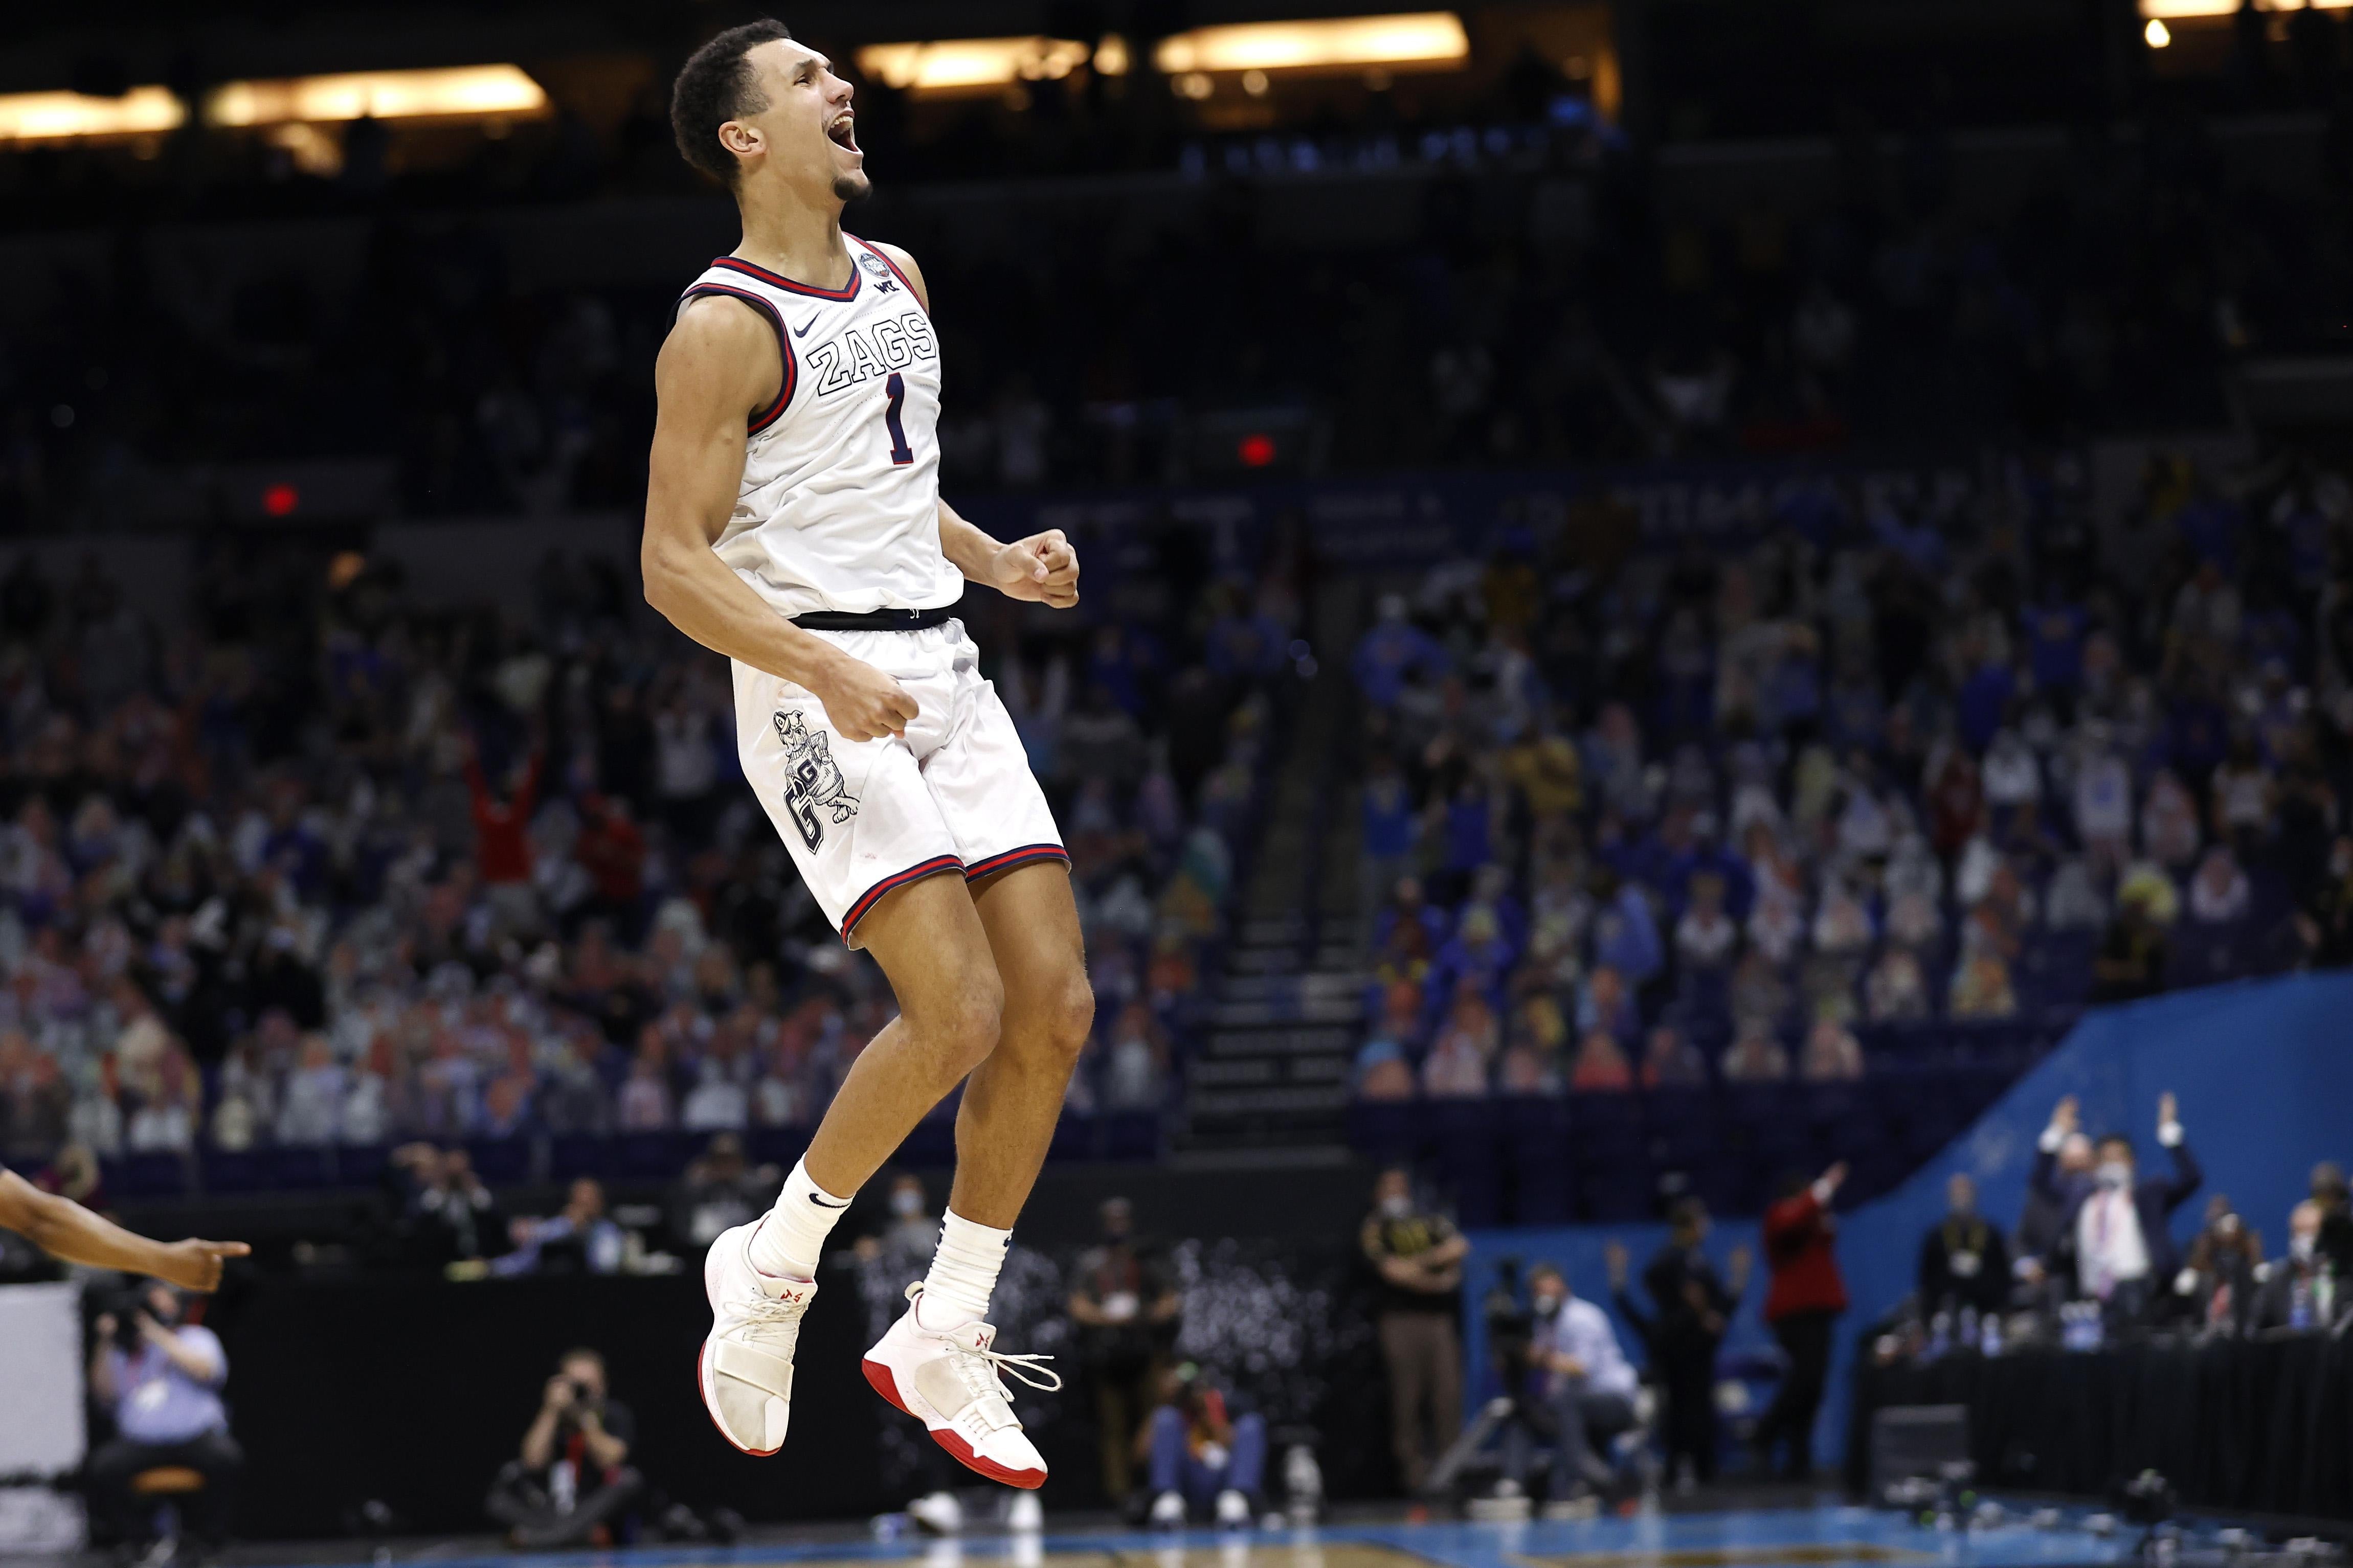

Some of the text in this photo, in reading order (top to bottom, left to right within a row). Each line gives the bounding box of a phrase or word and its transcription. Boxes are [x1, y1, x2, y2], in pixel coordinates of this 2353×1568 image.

[806, 312, 936, 396] ZAGS
[885, 372, 914, 465] 1
[797, 759, 818, 784] G
[783, 777, 824, 855] G
